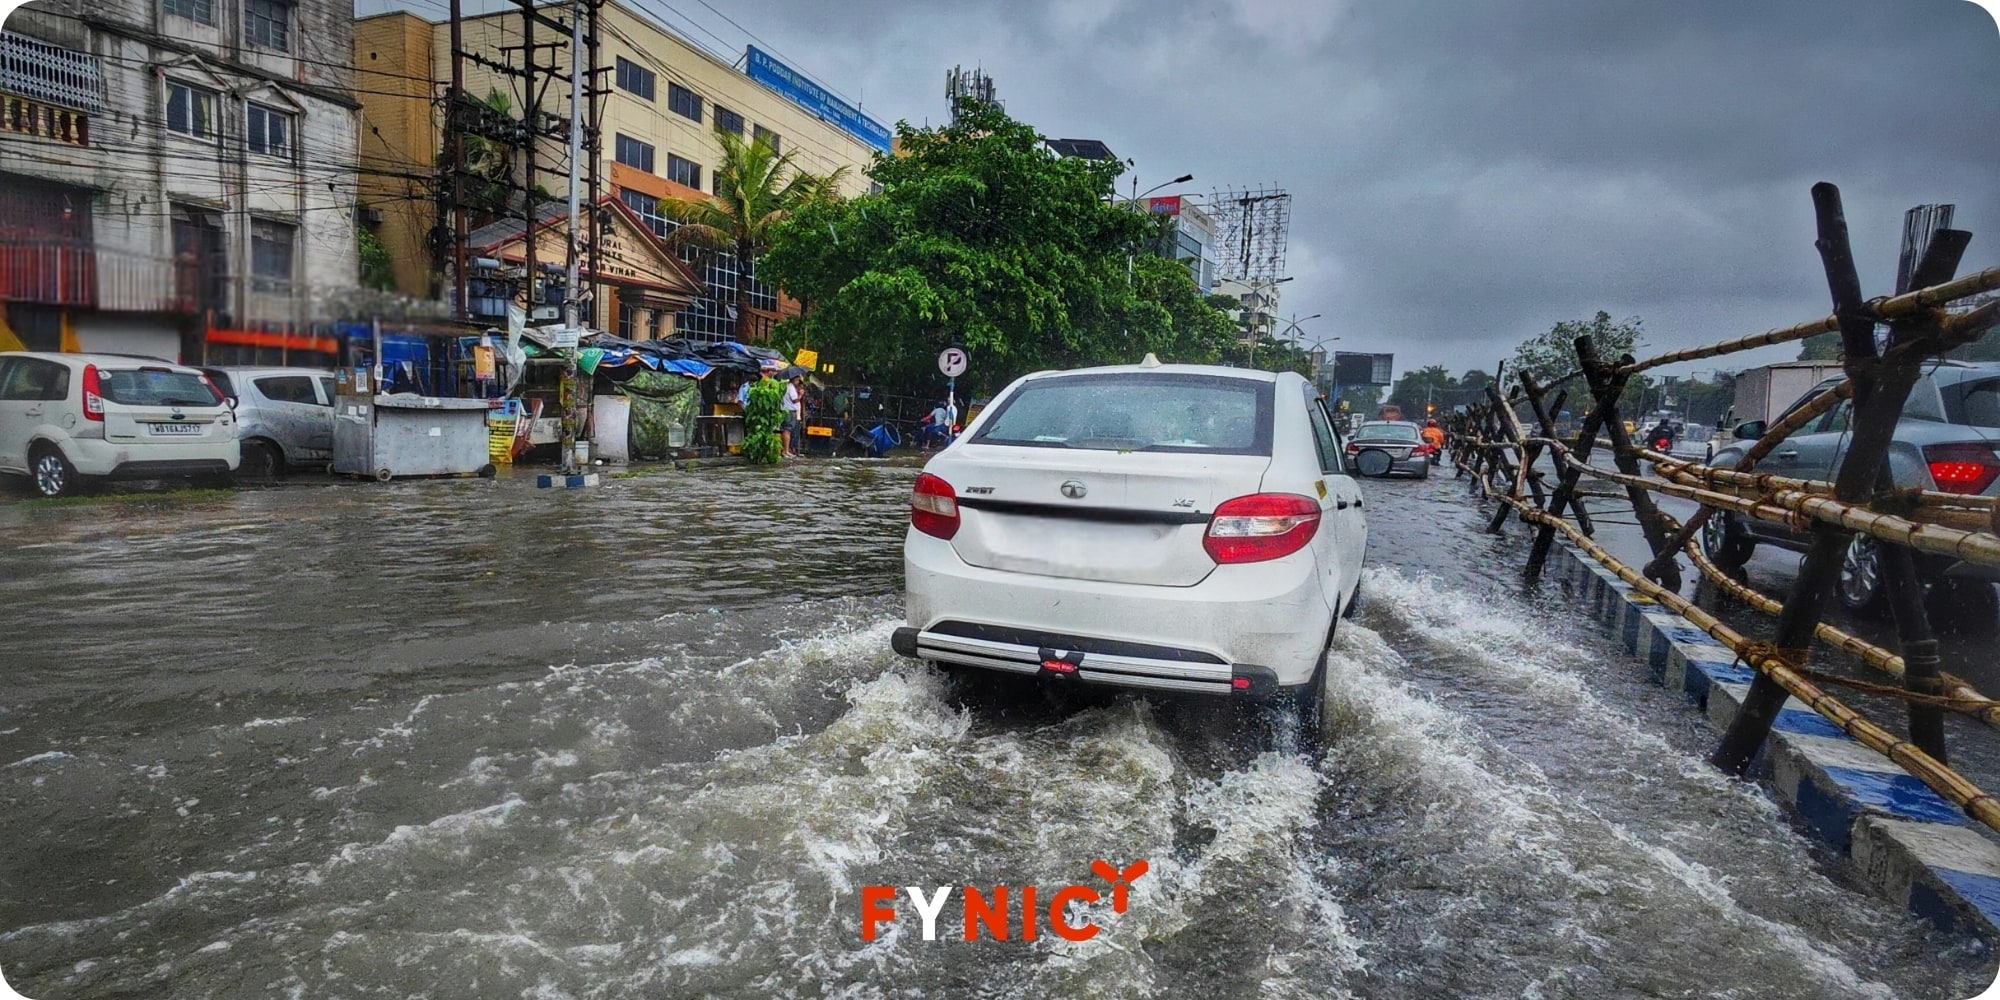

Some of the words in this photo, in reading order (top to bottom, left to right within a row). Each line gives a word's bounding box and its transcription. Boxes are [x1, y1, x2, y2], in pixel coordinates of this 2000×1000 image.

[755, 52, 761, 65] B.
[762, 57, 768, 68] P.
[768, 61, 792, 82] PODDAR
[792, 75, 819, 99] INSTITUTE
[819, 91, 826, 102] OF
[826, 96, 858, 122] MANAGEMENT
[862, 119, 889, 141] TECHNOLOGY
[609, 266, 636, 278] VIHAR
[1173, 498, 1195, 508] XE
